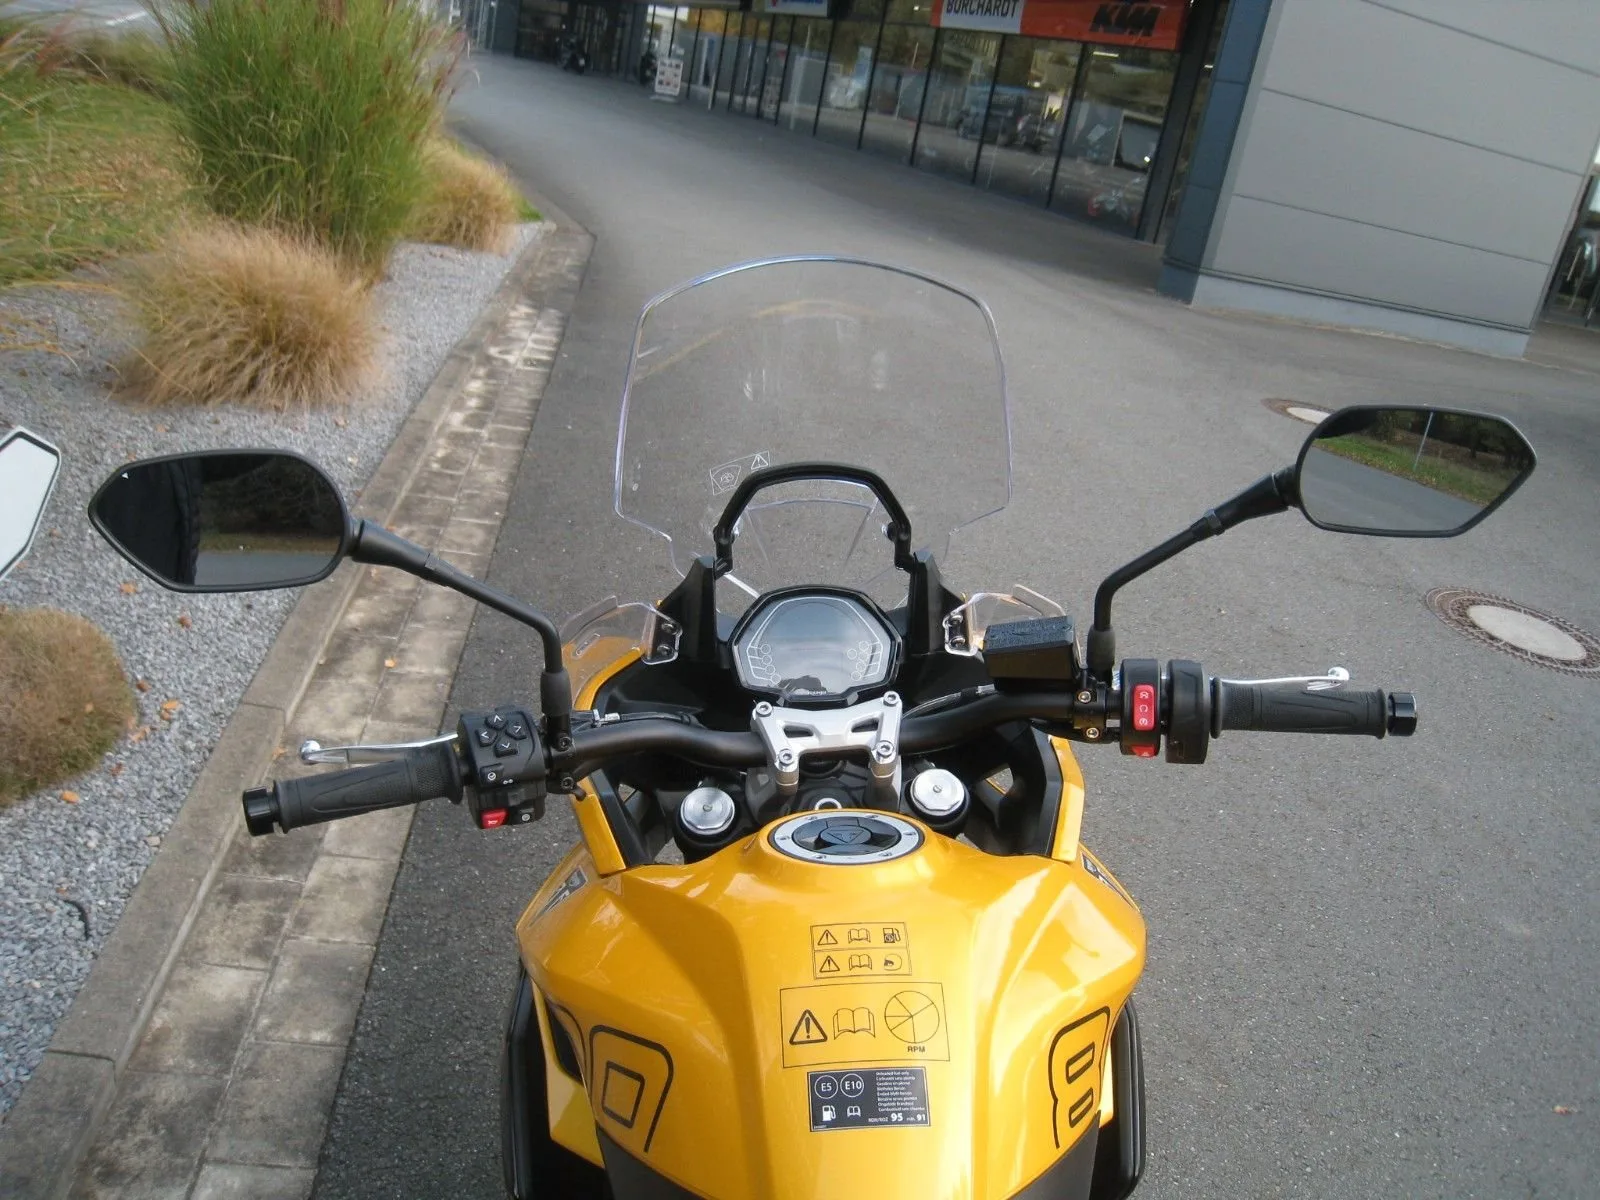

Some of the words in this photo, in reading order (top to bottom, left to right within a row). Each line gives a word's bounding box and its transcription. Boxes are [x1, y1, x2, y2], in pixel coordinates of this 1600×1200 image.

[1089, 4, 1161, 36] KTM
[907, 1045, 926, 1053] RPM
[821, 1082, 832, 1092] E5
[845, 1081, 862, 1090] E10
[891, 1113, 903, 1122] 95
